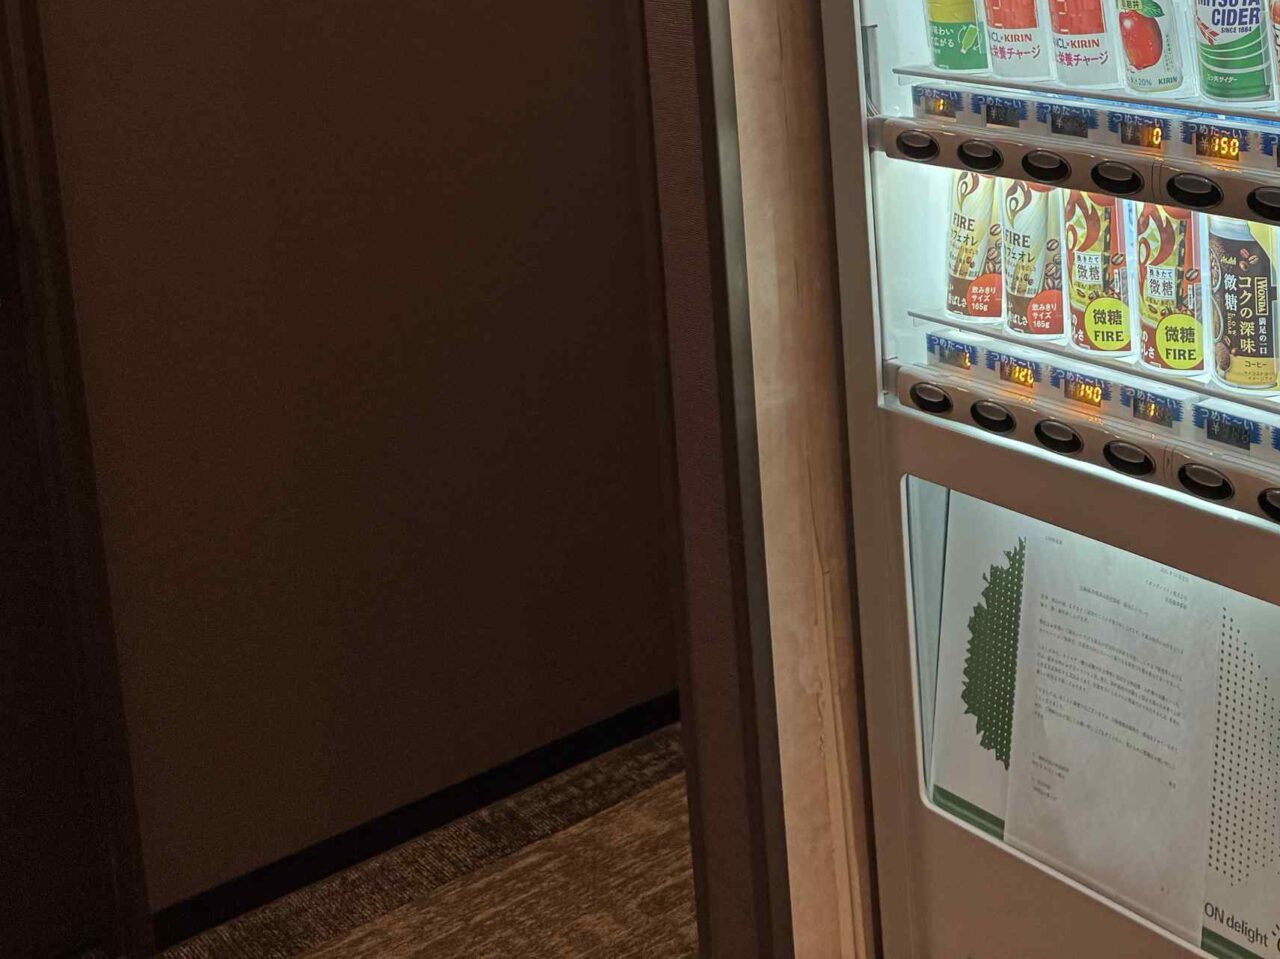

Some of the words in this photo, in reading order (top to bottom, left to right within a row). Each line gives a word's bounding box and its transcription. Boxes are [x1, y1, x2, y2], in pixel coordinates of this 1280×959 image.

[1212, 8, 1260, 26] CIDER
[1004, 33, 1032, 43] KIRIN
[1071, 39, 1100, 49] KIRIN
[1158, 77, 1177, 85] KIRIN
[953, 213, 975, 232] FIRE
[1076, 264, 1101, 281] 微糖
[1149, 279, 1174, 297] 微糖
[1223, 274, 1238, 311] 微糖
[1093, 309, 1122, 326] 微糖
[1238, 275, 1256, 354] コクの深味
[1094, 330, 1124, 343] FIRE
[1165, 325, 1195, 344] 微糖
[1165, 348, 1197, 361] FIRE
[1244, 360, 1267, 368] コーヒー
[1204, 902, 1224, 923] ON
[1226, 915, 1268, 947] delight
